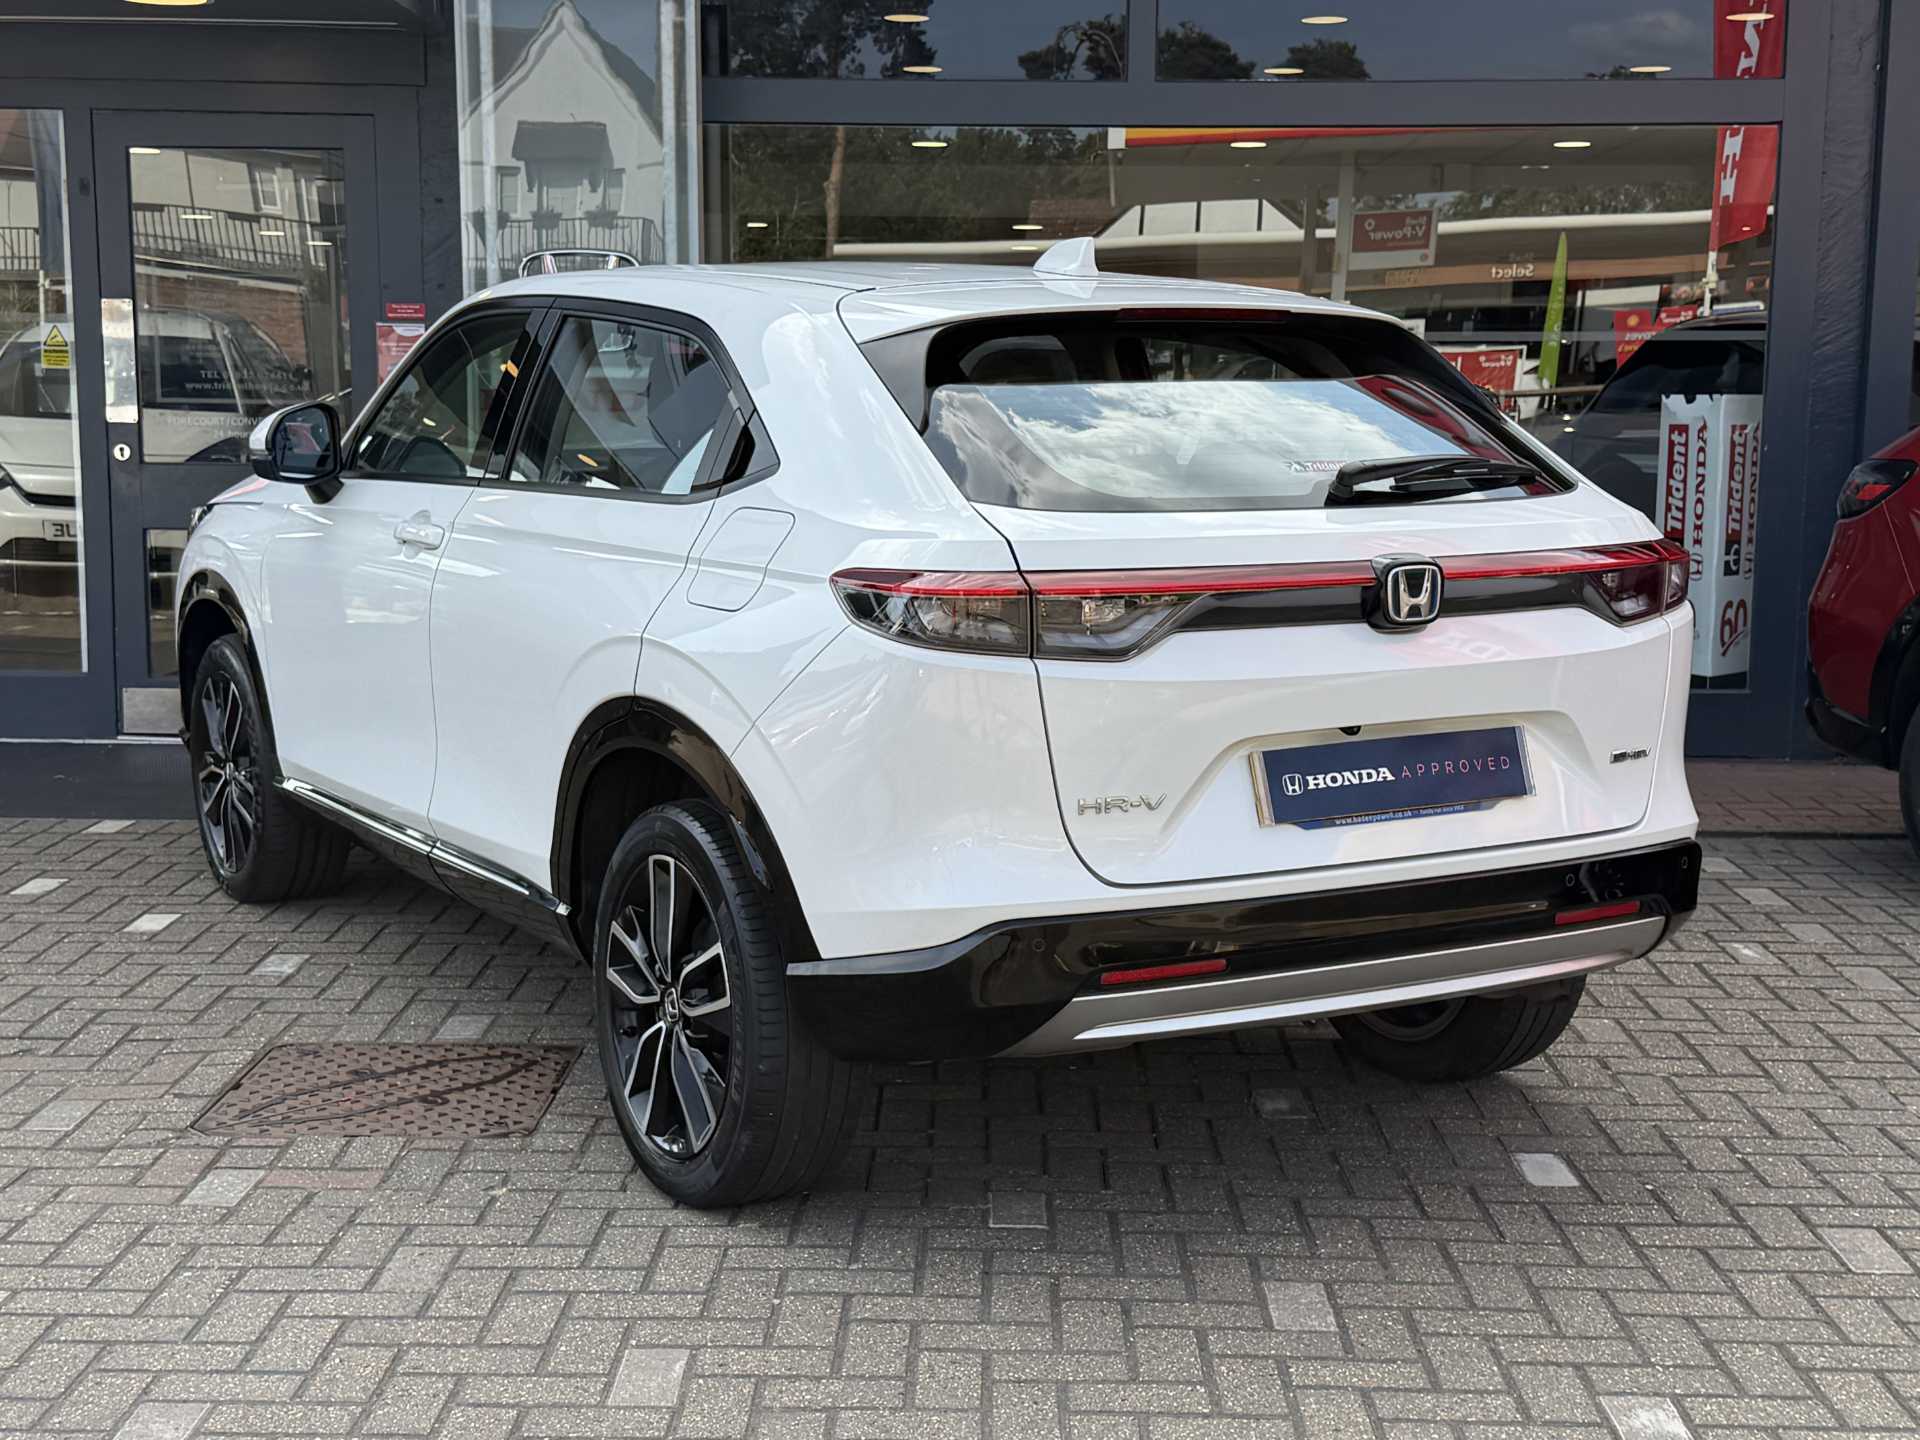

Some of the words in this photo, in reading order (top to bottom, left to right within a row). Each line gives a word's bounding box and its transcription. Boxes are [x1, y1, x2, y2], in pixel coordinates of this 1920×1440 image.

[1667, 429, 1688, 532] Trident
[1692, 415, 1708, 547] HONDA
[1077, 792, 1168, 816] HR-V
[1306, 767, 1395, 790] HONDA
[1401, 755, 1511, 780] APPROVED
